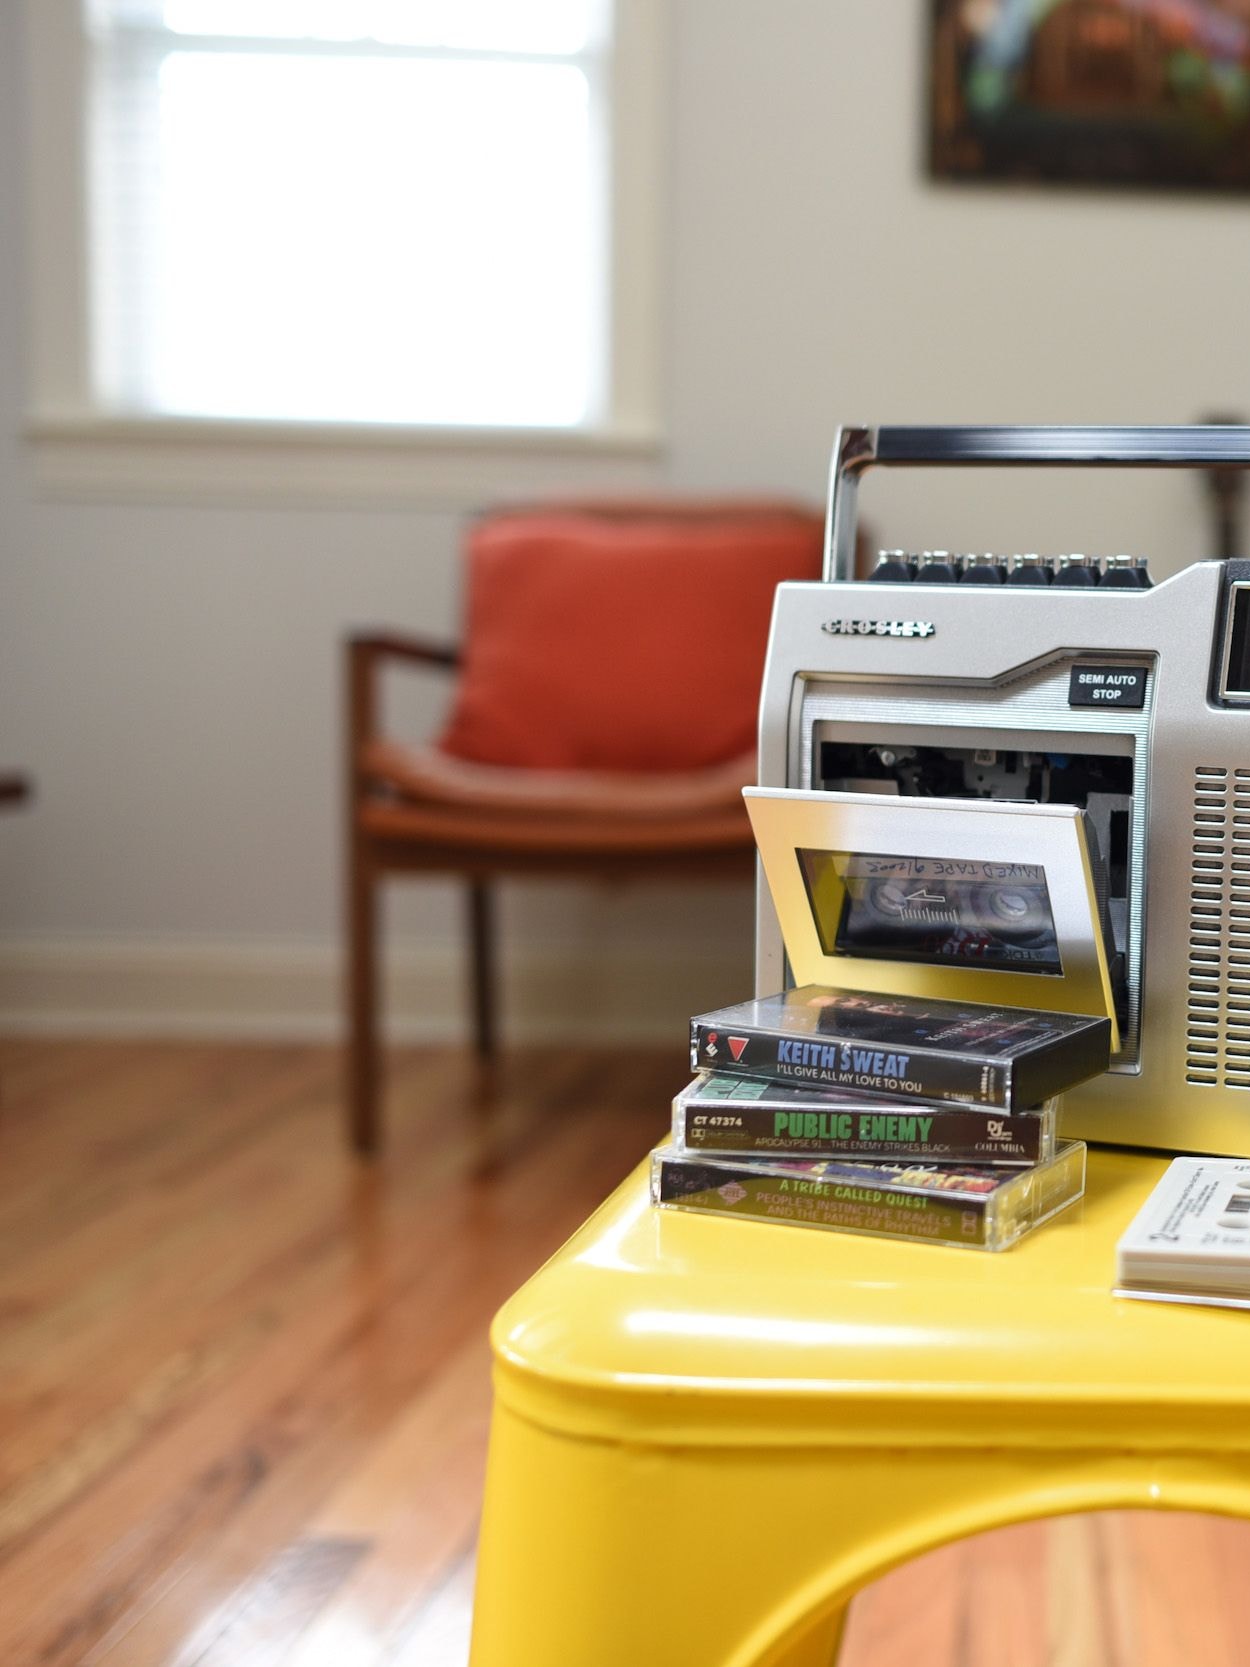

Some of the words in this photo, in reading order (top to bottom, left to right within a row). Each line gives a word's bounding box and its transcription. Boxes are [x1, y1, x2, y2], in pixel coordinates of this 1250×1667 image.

[822, 619, 935, 637] CROSLEY
[1078, 673, 1105, 685] SEMI
[1106, 675, 1137, 686] AUTO
[1092, 689, 1122, 700] STOP
[934, 862, 978, 875] TAPE
[983, 863, 1039, 880] MIXED
[778, 1040, 836, 1069] KEITH
[840, 1044, 910, 1079] SWEAT
[776, 1064, 792, 1076] I'LL
[794, 1066, 818, 1079] GIVE
[820, 1070, 837, 1082] ALL
[839, 1073, 854, 1084] MY
[855, 1075, 881, 1088] LOVE
[883, 1078, 898, 1090] TO
[899, 1081, 922, 1093] YOU
[693, 1115, 709, 1126] CT
[709, 1116, 743, 1127] 47374
[774, 1112, 853, 1140] PUBLIC
[859, 1115, 934, 1143] ENEMY
[754, 1137, 811, 1149] APOCALYPSE
[831, 1140, 848, 1150] THE
[850, 1141, 881, 1151] ENEMY
[884, 1142, 919, 1152] STRIKES
[921, 1143, 951, 1153] BLACK
[974, 1142, 1025, 1153] COLUMBIA
[779, 1179, 790, 1192] A
[793, 1180, 831, 1197] TRIBE
[834, 1186, 882, 1204] CALLED
[886, 1193, 929, 1209] QUEST
[755, 1191, 814, 1210] PEOPLE'S
[817, 1200, 894, 1220] INSTINCTIVE
[896, 1209, 952, 1228] TRAVELS
[767, 1205, 794, 1217] AND
